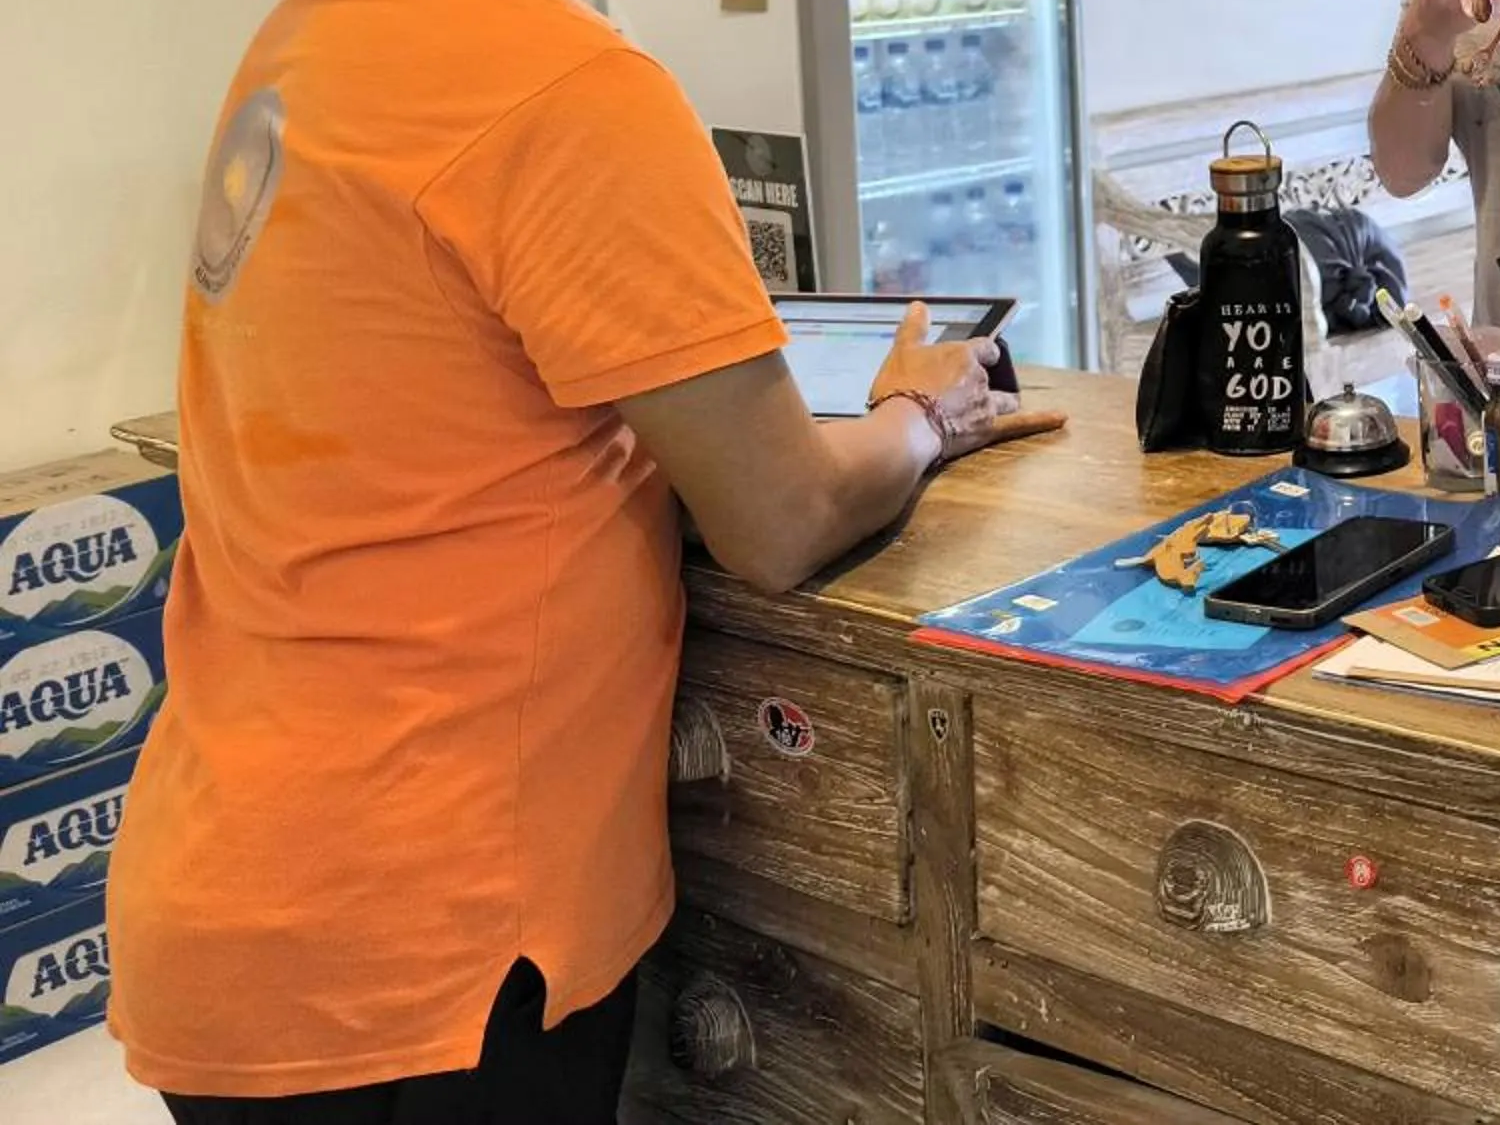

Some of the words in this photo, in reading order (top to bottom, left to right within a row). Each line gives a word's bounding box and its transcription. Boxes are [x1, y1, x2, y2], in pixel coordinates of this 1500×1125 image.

[764, 181, 799, 208] HERE
[1221, 320, 1286, 352] YO
[1225, 373, 1293, 400] GOD
[8, 524, 138, 596] AQUA
[0, 660, 132, 733] AQUA
[24, 794, 124, 866] AQU
[30, 932, 110, 998] AQ
